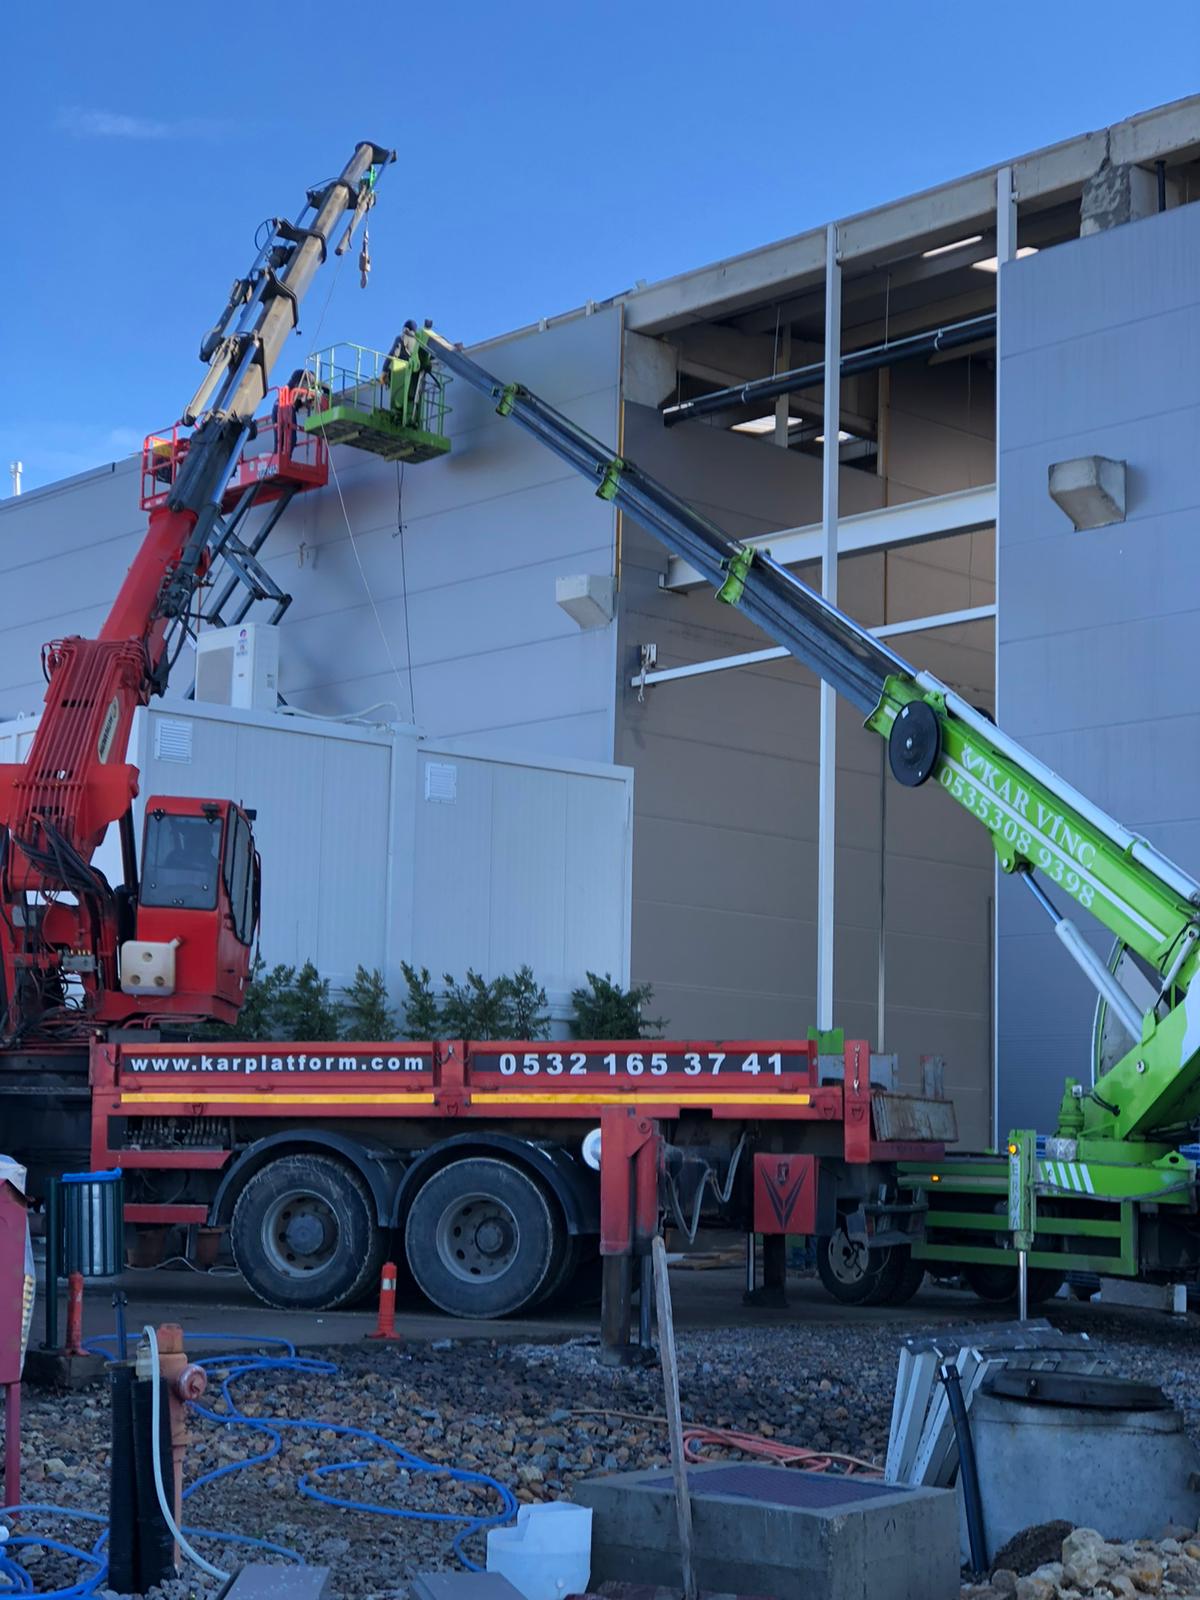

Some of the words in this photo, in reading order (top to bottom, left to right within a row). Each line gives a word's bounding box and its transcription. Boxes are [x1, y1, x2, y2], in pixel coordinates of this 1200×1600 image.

[980, 761, 1030, 817] KAR
[1038, 847, 1095, 908] 9398
[131, 1054, 424, 1074] www.karplatform.com
[499, 1053, 587, 1075] 0532
[603, 1053, 668, 1075] 165
[684, 1053, 726, 1075] 37
[742, 1053, 782, 1075] 41
